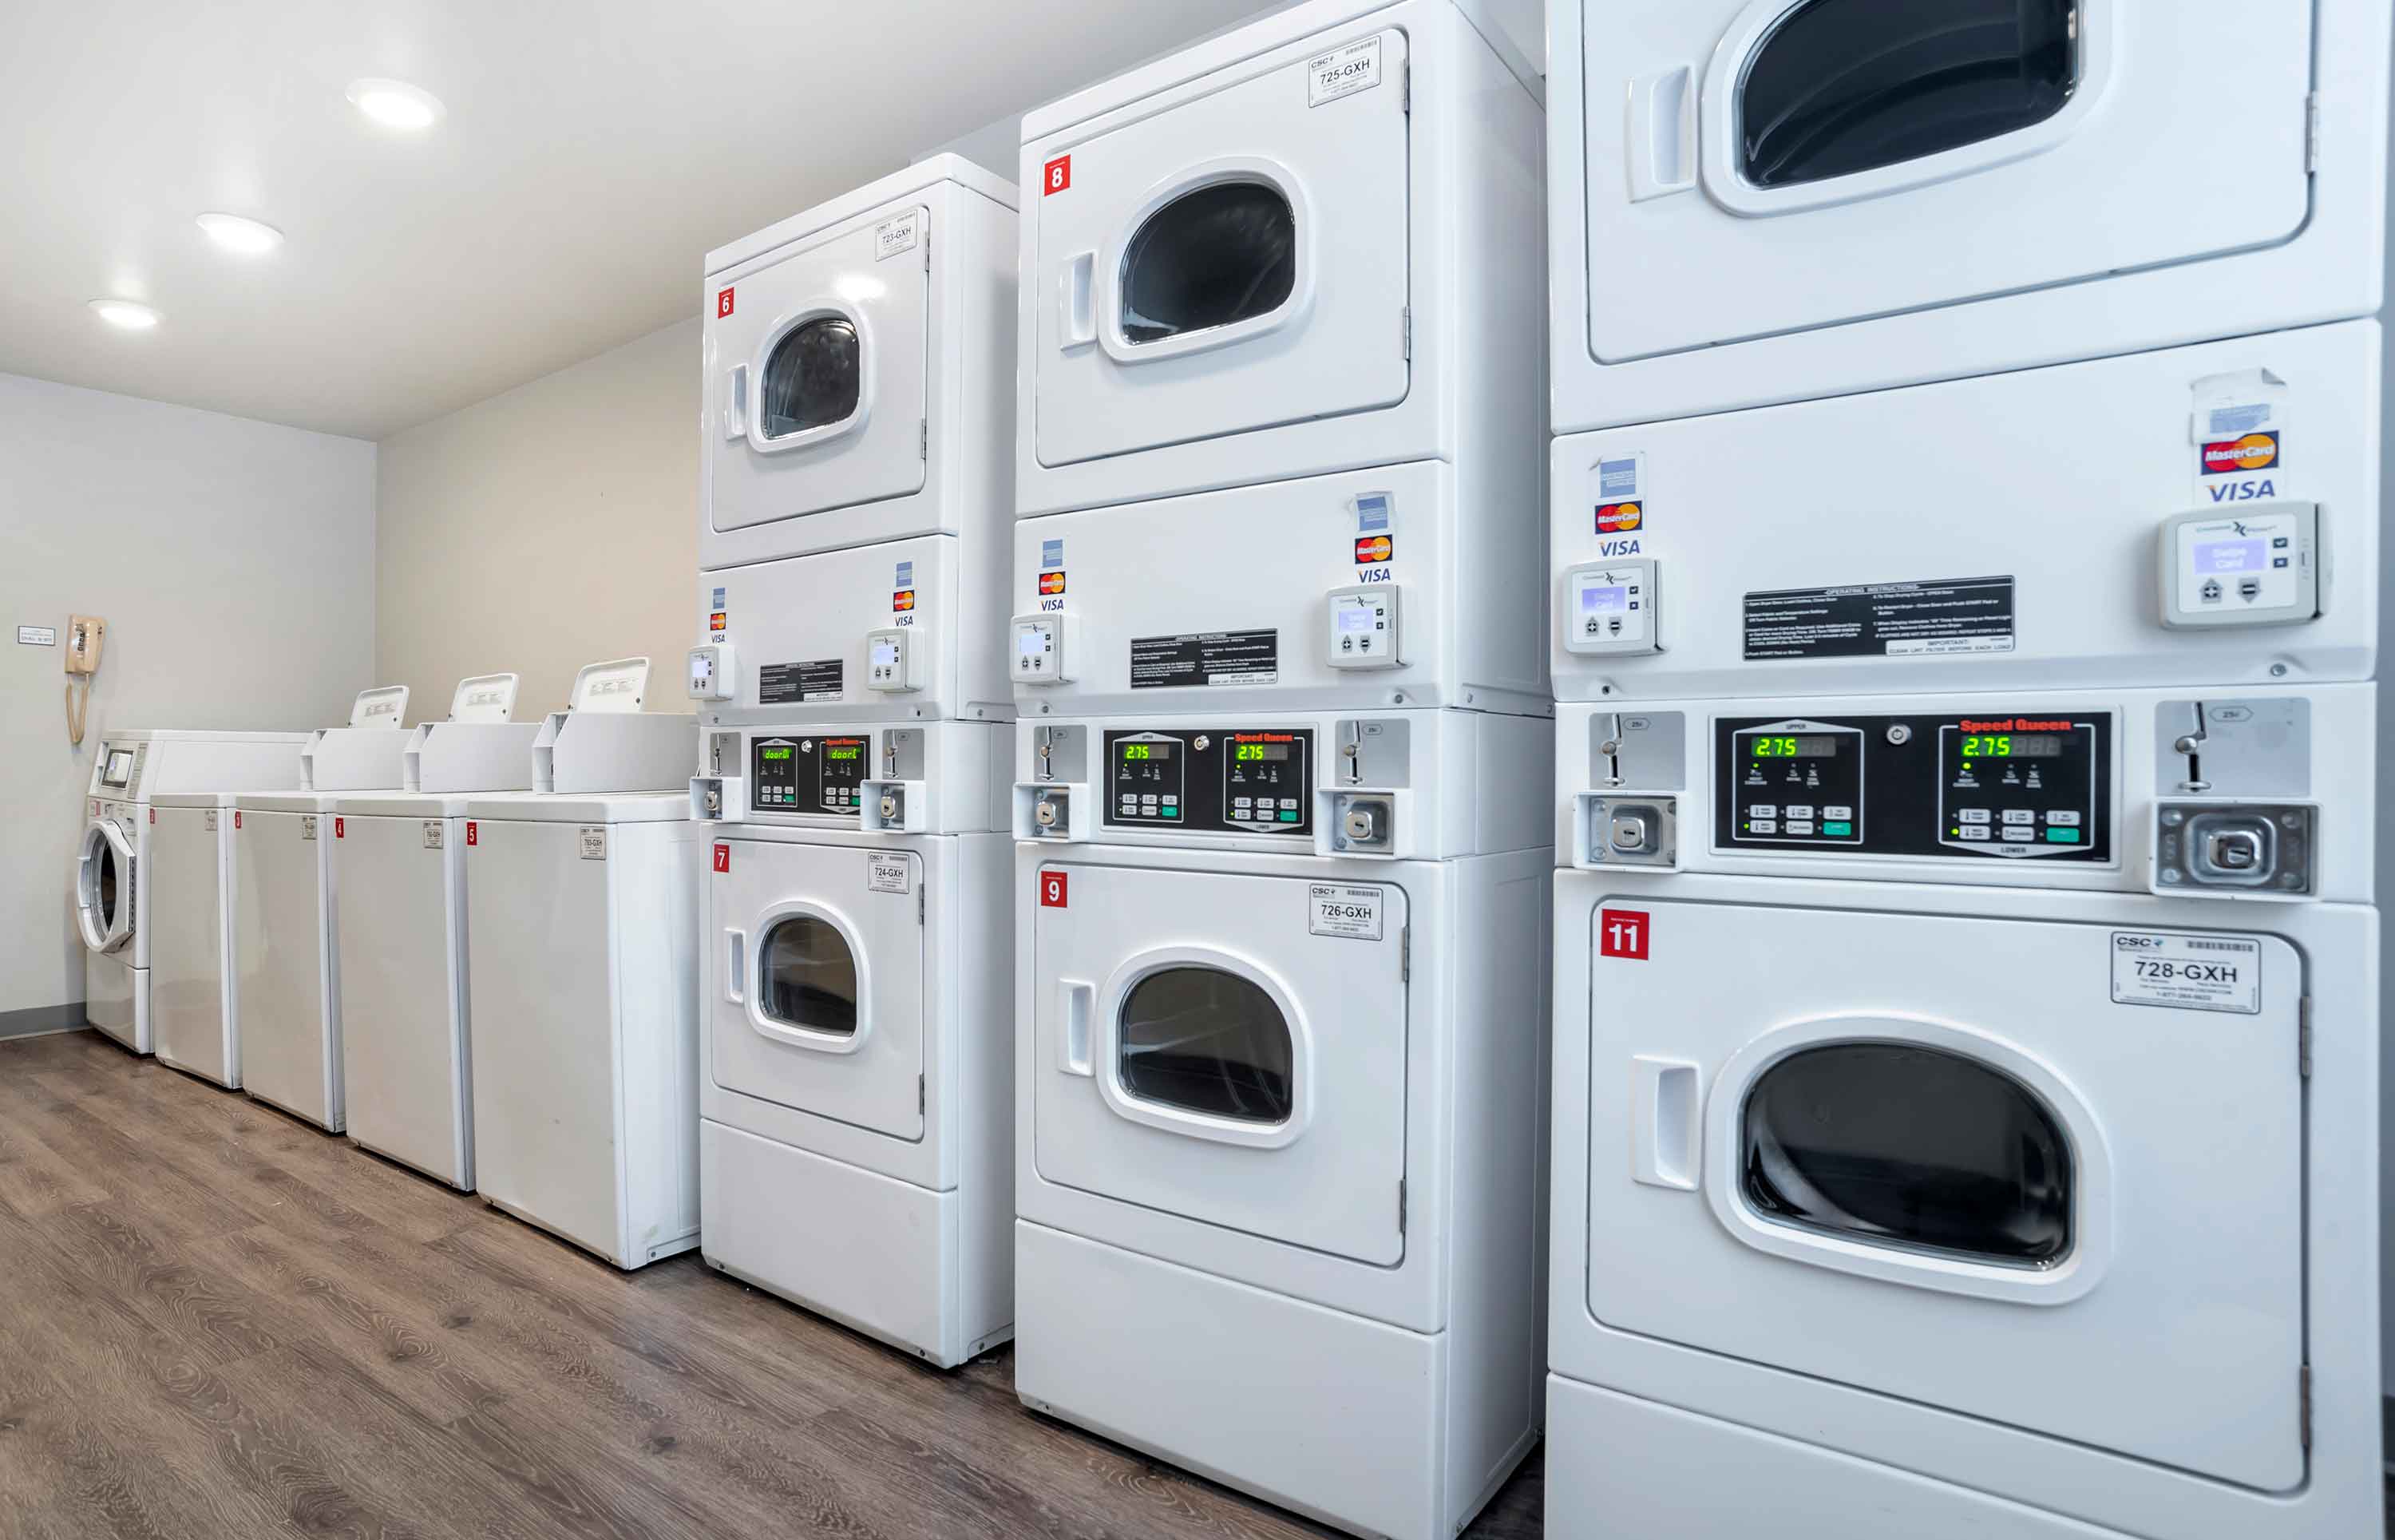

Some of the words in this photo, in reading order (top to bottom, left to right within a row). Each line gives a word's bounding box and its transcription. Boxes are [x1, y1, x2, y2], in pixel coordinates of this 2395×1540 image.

[1320, 57, 1370, 85] 725-GXH
[1051, 167, 1063, 188] 8
[722, 296, 730, 313] 6
[2204, 444, 2277, 462] MasterCard
[2207, 480, 2275, 502] VISA
[1597, 512, 1641, 524] MasterCard
[1599, 539, 1641, 557] VISA
[1359, 568, 1391, 584] VISA
[1041, 599, 1064, 612] VISA
[895, 616, 913, 627] VISA
[711, 634, 726, 643] VISA
[1960, 719, 2013, 733] Speed
[2015, 719, 2072, 730] Queen
[1234, 734, 1263, 742] Speed
[1264, 733, 1293, 742] Queen
[1126, 746, 1149, 759] 2.75
[1238, 746, 1264, 759] 2.75
[1756, 738, 1796, 755] 2.75
[1963, 737, 2010, 756] 2.75
[469, 828, 474, 842] 5
[718, 852, 726, 869] 7
[875, 867, 904, 878] 724-GXH
[1048, 881, 1060, 901] 9
[1321, 905, 1372, 920] 726-GXH
[1609, 924, 1637, 952] 11
[2116, 936, 2152, 947] CSC
[2135, 960, 2238, 983] 728-GXH
